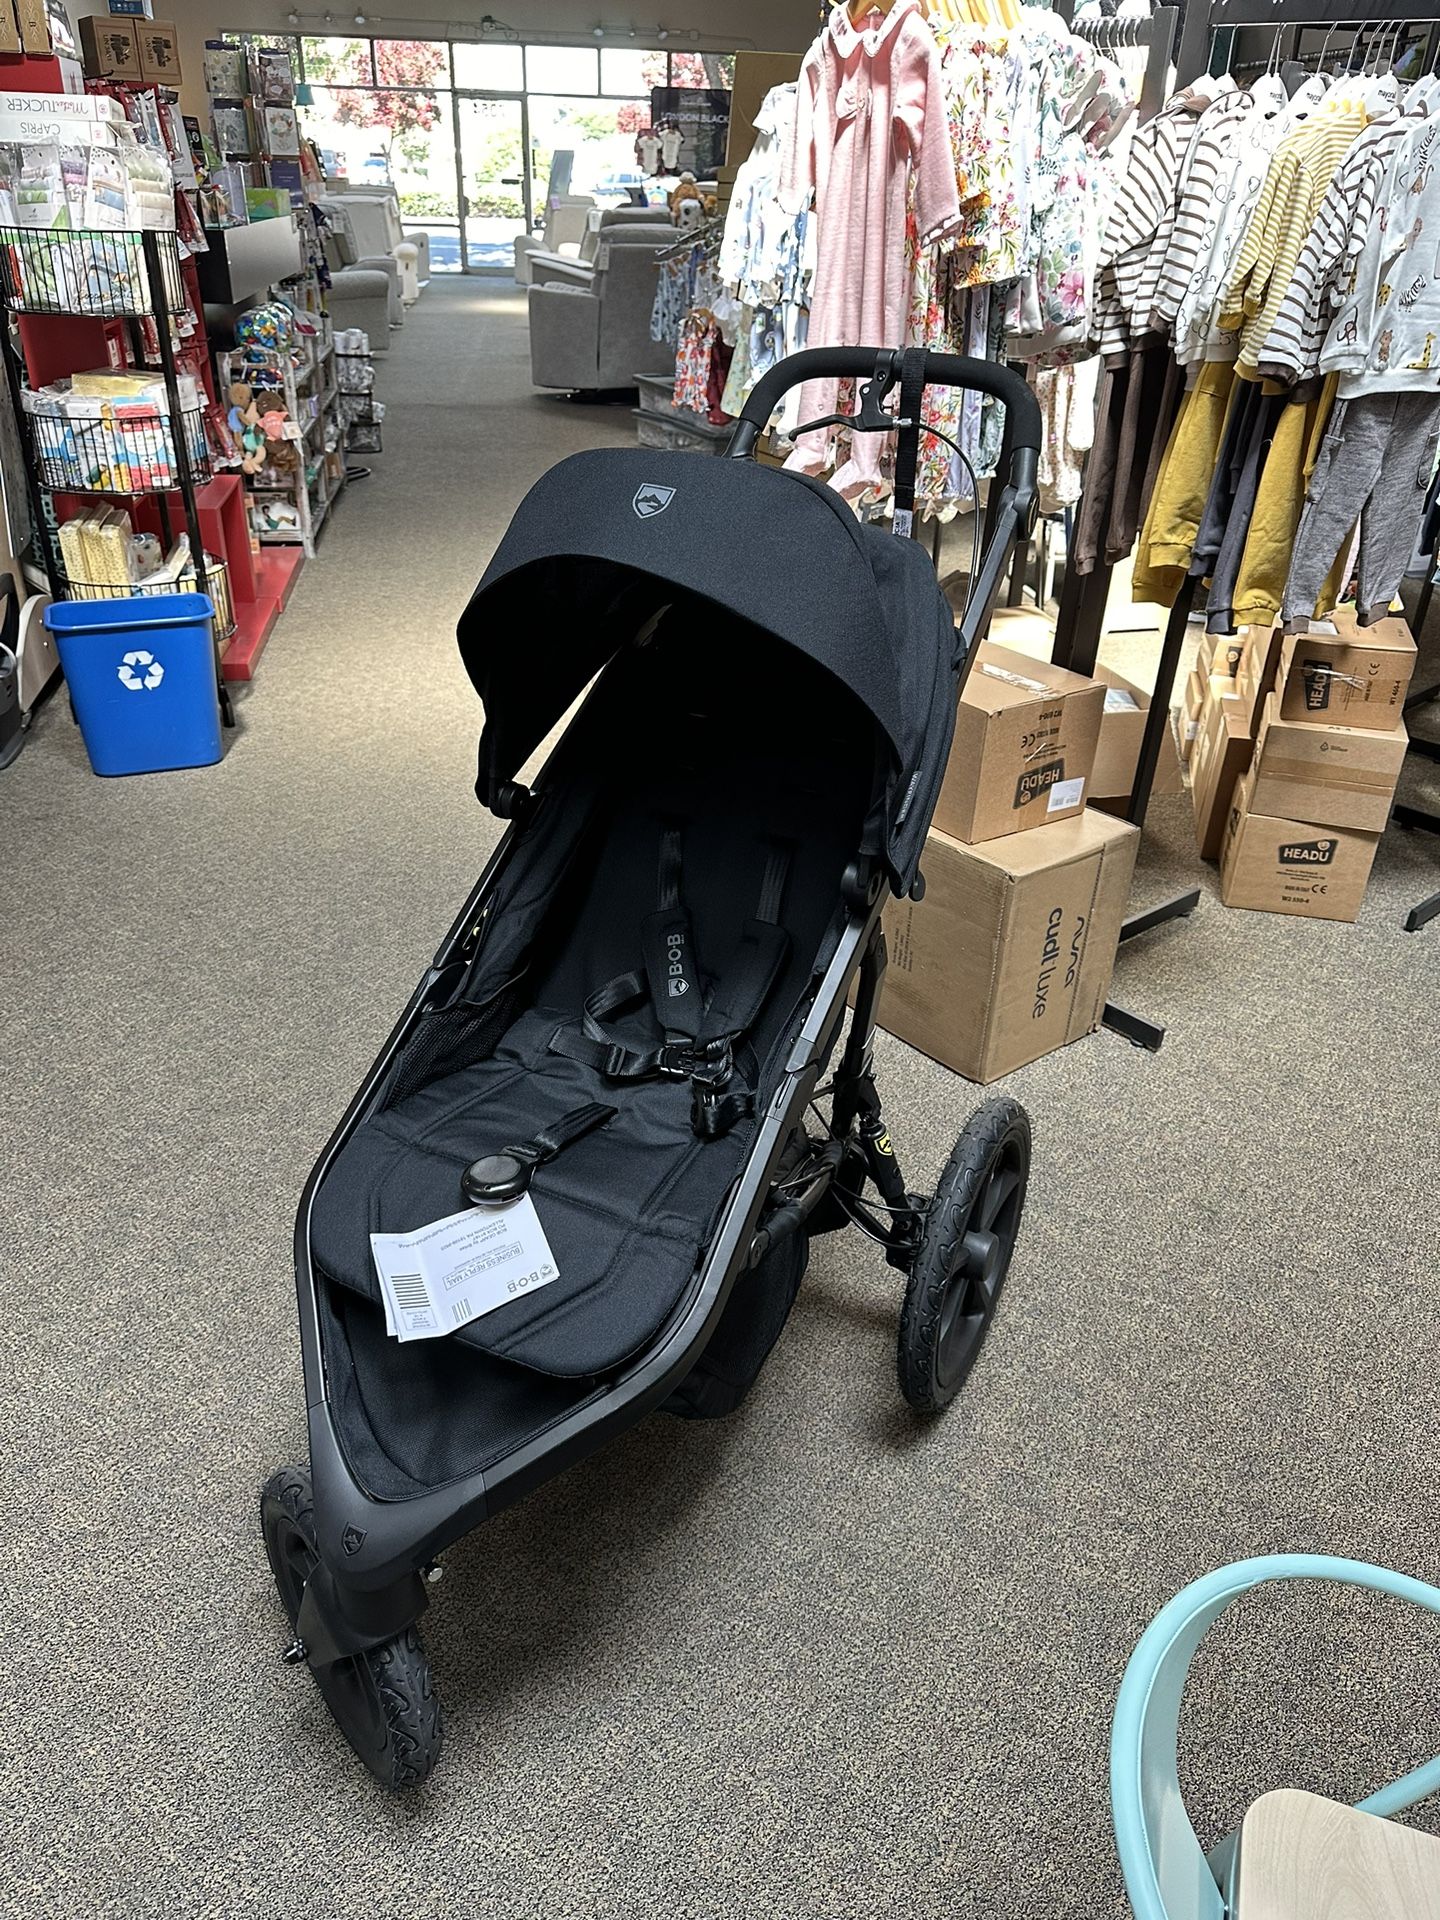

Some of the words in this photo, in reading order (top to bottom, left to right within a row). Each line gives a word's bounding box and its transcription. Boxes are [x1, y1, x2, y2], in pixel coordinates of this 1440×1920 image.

[7, 98, 57, 113] TUCKER
[661, 112, 699, 122] LONDON
[21, 122, 61, 135] CAPRIS
[1021, 769, 1060, 791] HEADU
[1283, 847, 1330, 861] HEADU
[1064, 916, 1085, 988] nuna
[1032, 966, 1057, 1019] luxe
[487, 1246, 521, 1267] BUSINESS
[463, 1263, 487, 1279] REPLY
[446, 1274, 463, 1287] MAIL
